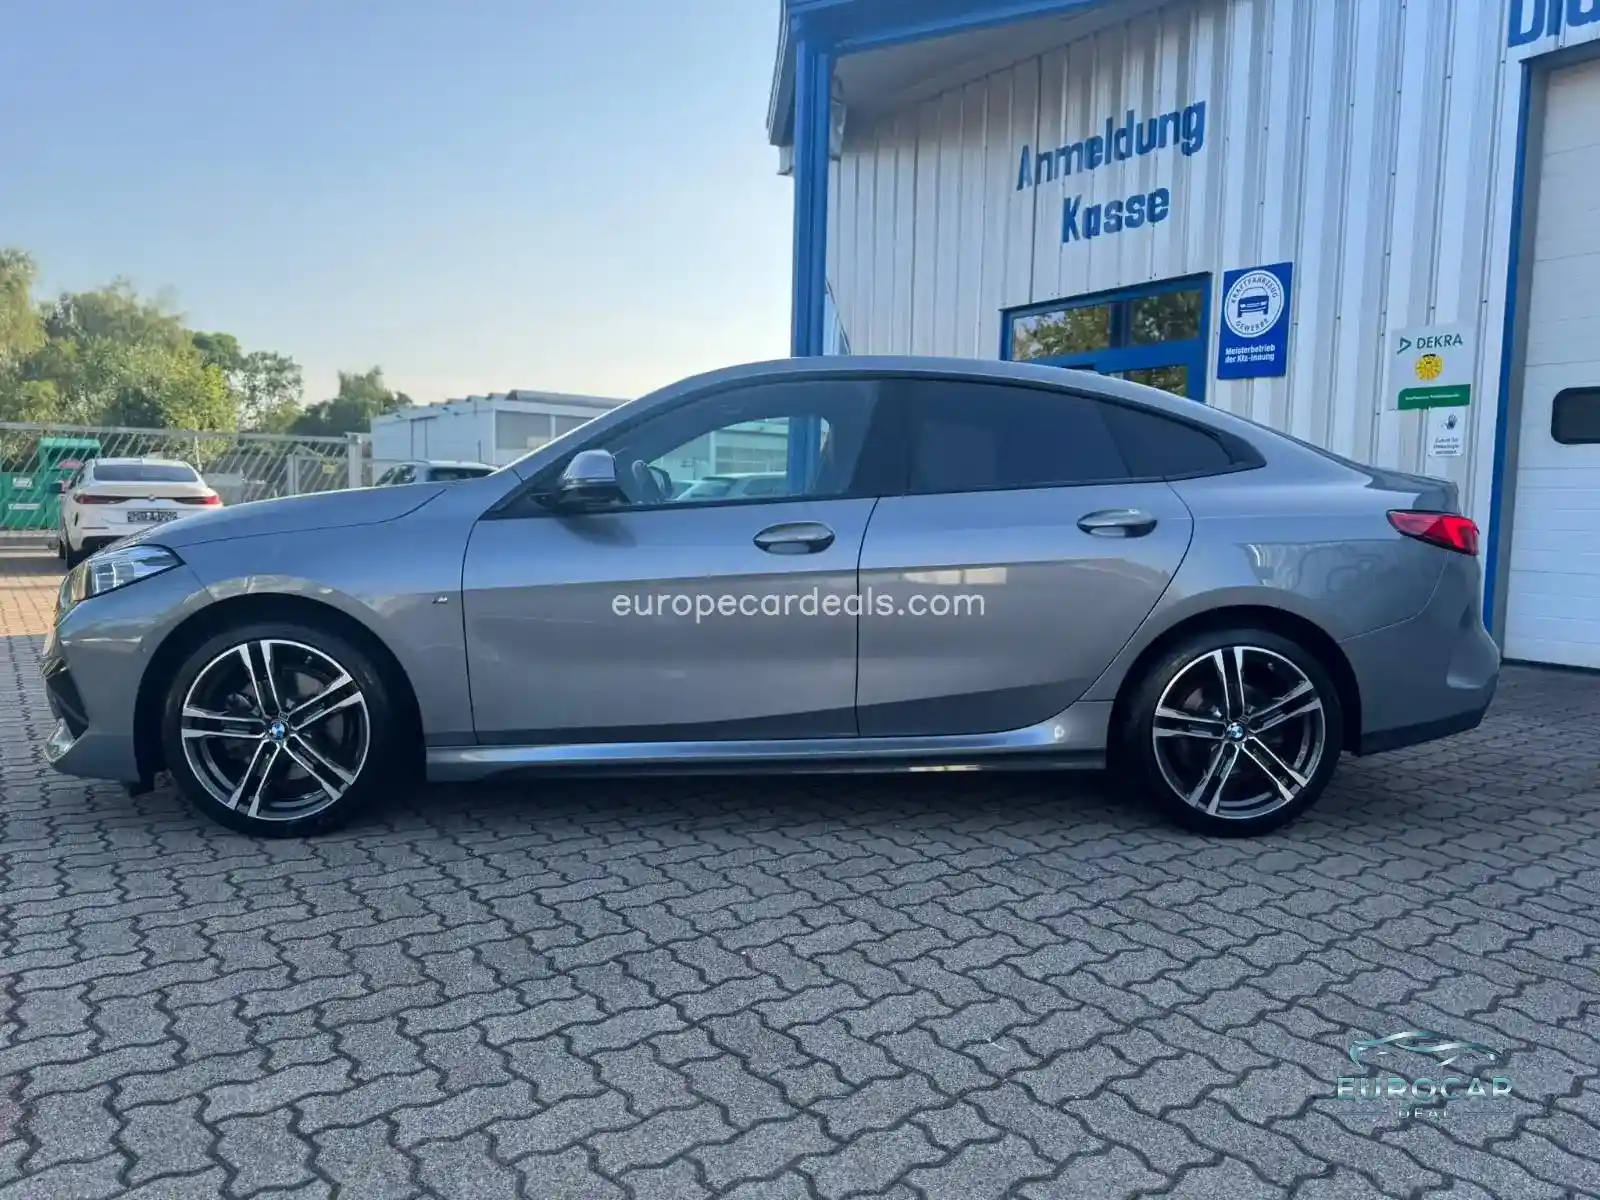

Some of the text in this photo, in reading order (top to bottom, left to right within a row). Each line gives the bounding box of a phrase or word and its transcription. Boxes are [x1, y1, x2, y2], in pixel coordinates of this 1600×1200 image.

[1016, 101, 1206, 190] Anmeldung
[1062, 188, 1170, 243] Kasse
[1231, 275, 1279, 304] KRAFTFAHRZEUG
[1225, 344, 1276, 355] Meisterbetrieb
[1417, 334, 1463, 349] DEKRA
